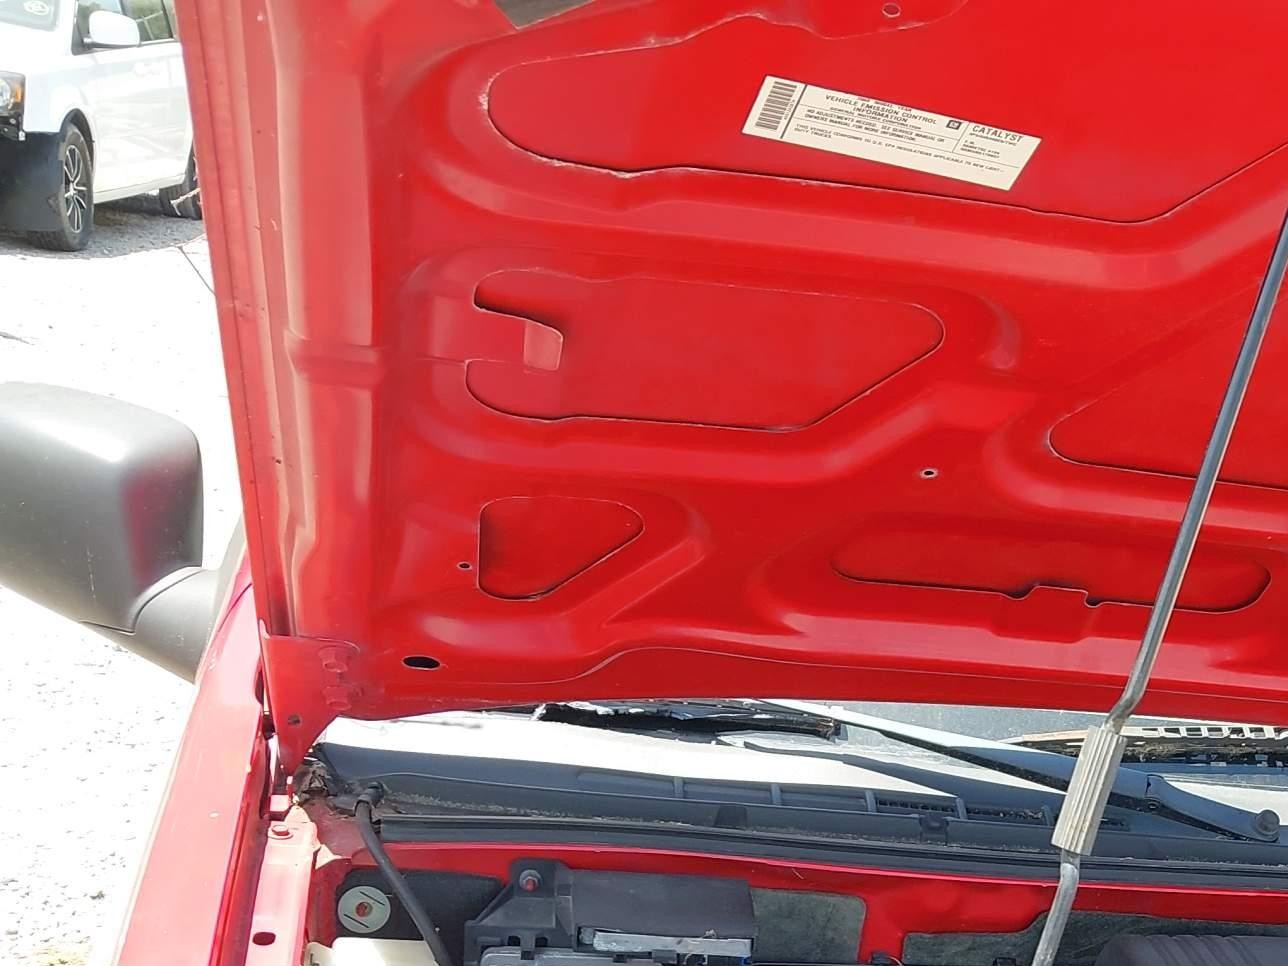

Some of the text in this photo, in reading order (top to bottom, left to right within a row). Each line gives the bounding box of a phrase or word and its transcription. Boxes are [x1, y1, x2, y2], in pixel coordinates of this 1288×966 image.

[824, 94, 859, 106] VEHICLE
[860, 102, 900, 115] EMISSION
[900, 111, 938, 124] CONTROL
[852, 106, 908, 122] INFORMATION
[815, 110, 854, 122] ADJUSTMENTS
[891, 127, 913, 135] SERVICE
[828, 118, 850, 126] MANUAL
[971, 125, 1024, 142] CATALYST
